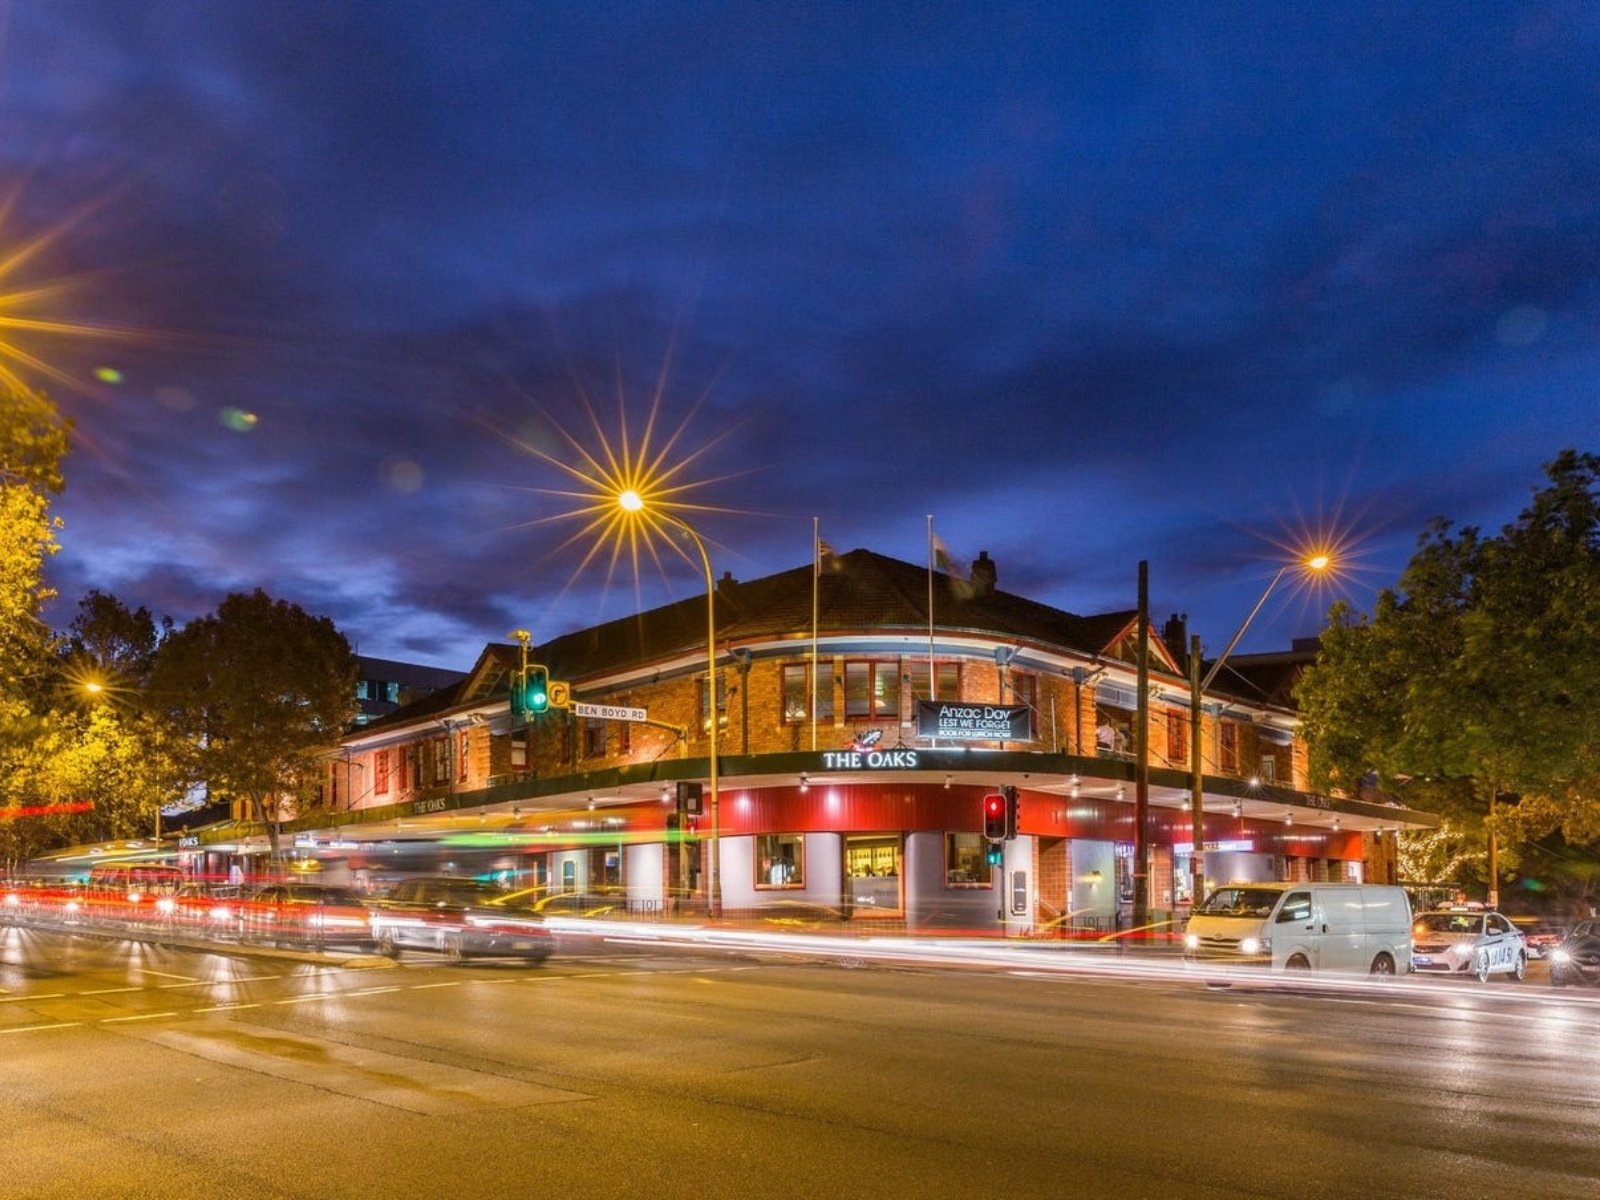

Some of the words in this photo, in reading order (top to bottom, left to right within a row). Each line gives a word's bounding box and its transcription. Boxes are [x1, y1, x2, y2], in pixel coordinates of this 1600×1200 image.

[578, 705, 597, 715] BEN
[601, 708, 627, 718] BOYD
[631, 710, 644, 719] RD
[939, 705, 981, 719] Anzac
[985, 706, 1011, 722] Day
[939, 718, 958, 727] LEST
[959, 719, 974, 728] WE
[976, 720, 1011, 730] FORGET
[823, 752, 862, 768] THE
[867, 751, 917, 767] OAKS
[414, 801, 426, 814] THE
[427, 797, 446, 812] OAKS
